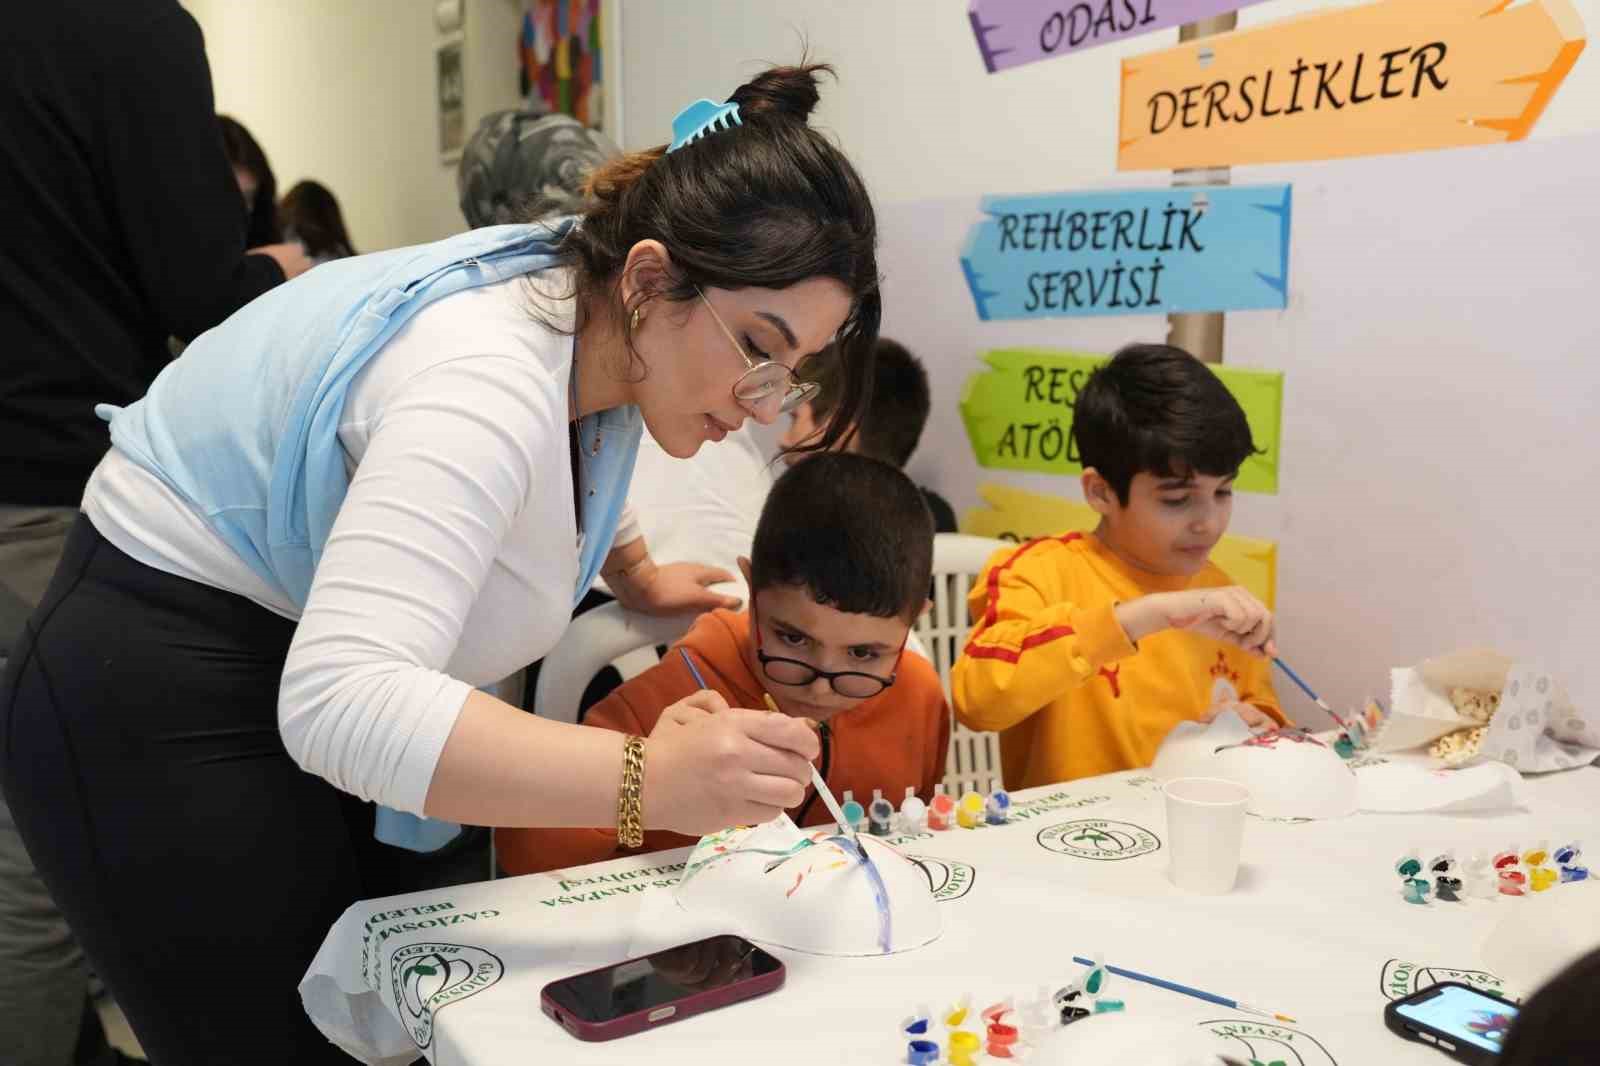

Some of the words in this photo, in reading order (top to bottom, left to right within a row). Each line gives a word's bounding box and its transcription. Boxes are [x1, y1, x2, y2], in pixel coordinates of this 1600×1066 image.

[1040, 0, 1156, 53] ODASI
[1147, 41, 1450, 135] DERSLİKLER
[999, 201, 1206, 254] REHBERLİK
[1025, 257, 1167, 312] SERVİSİ
[1024, 365, 1084, 409] RES
[997, 418, 1081, 463] ATÖL
[541, 876, 682, 908] OSMANPAŞA
[378, 909, 501, 941] GAZİOSM
